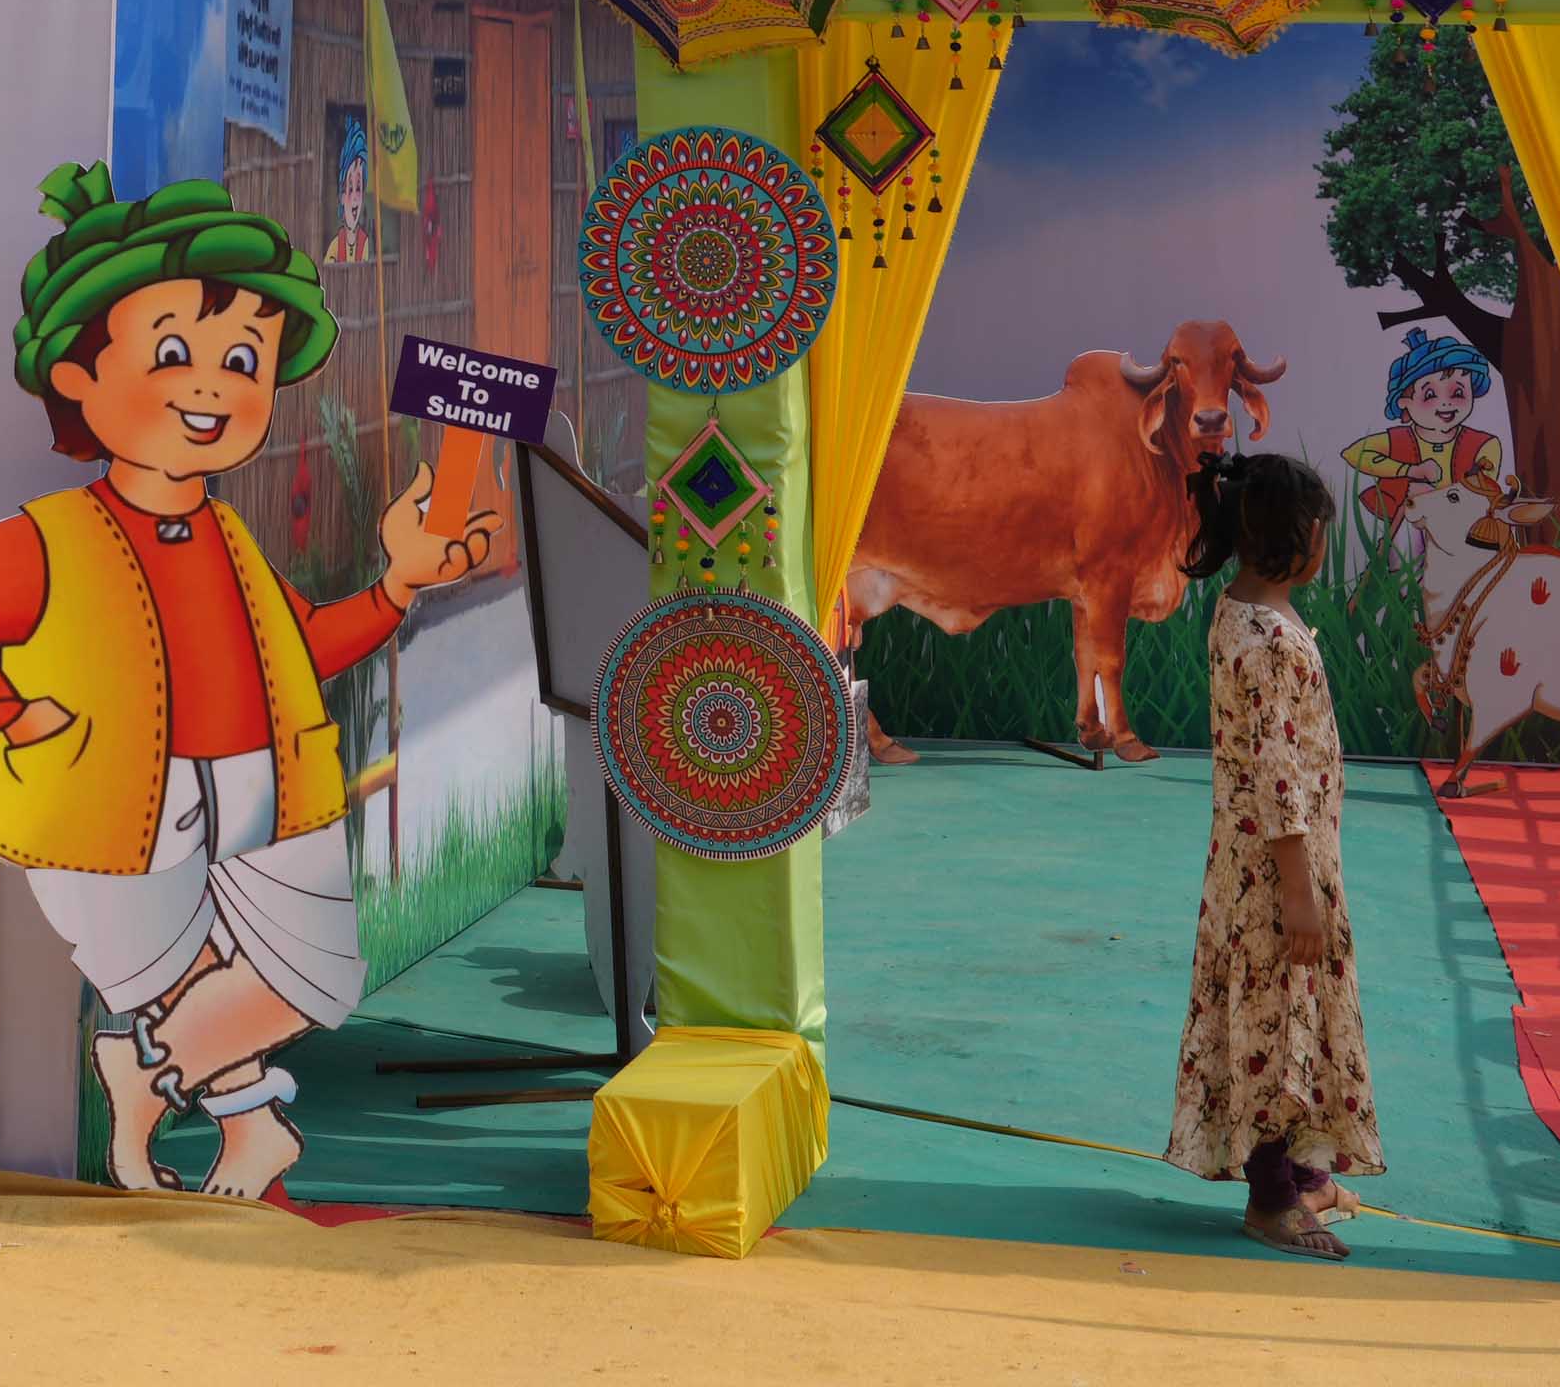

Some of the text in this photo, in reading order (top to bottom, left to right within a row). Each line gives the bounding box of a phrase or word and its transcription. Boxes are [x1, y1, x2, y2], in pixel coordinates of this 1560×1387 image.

[418, 343, 540, 389] Welcome
[458, 379, 488, 405] To
[427, 395, 512, 432] Sumul
